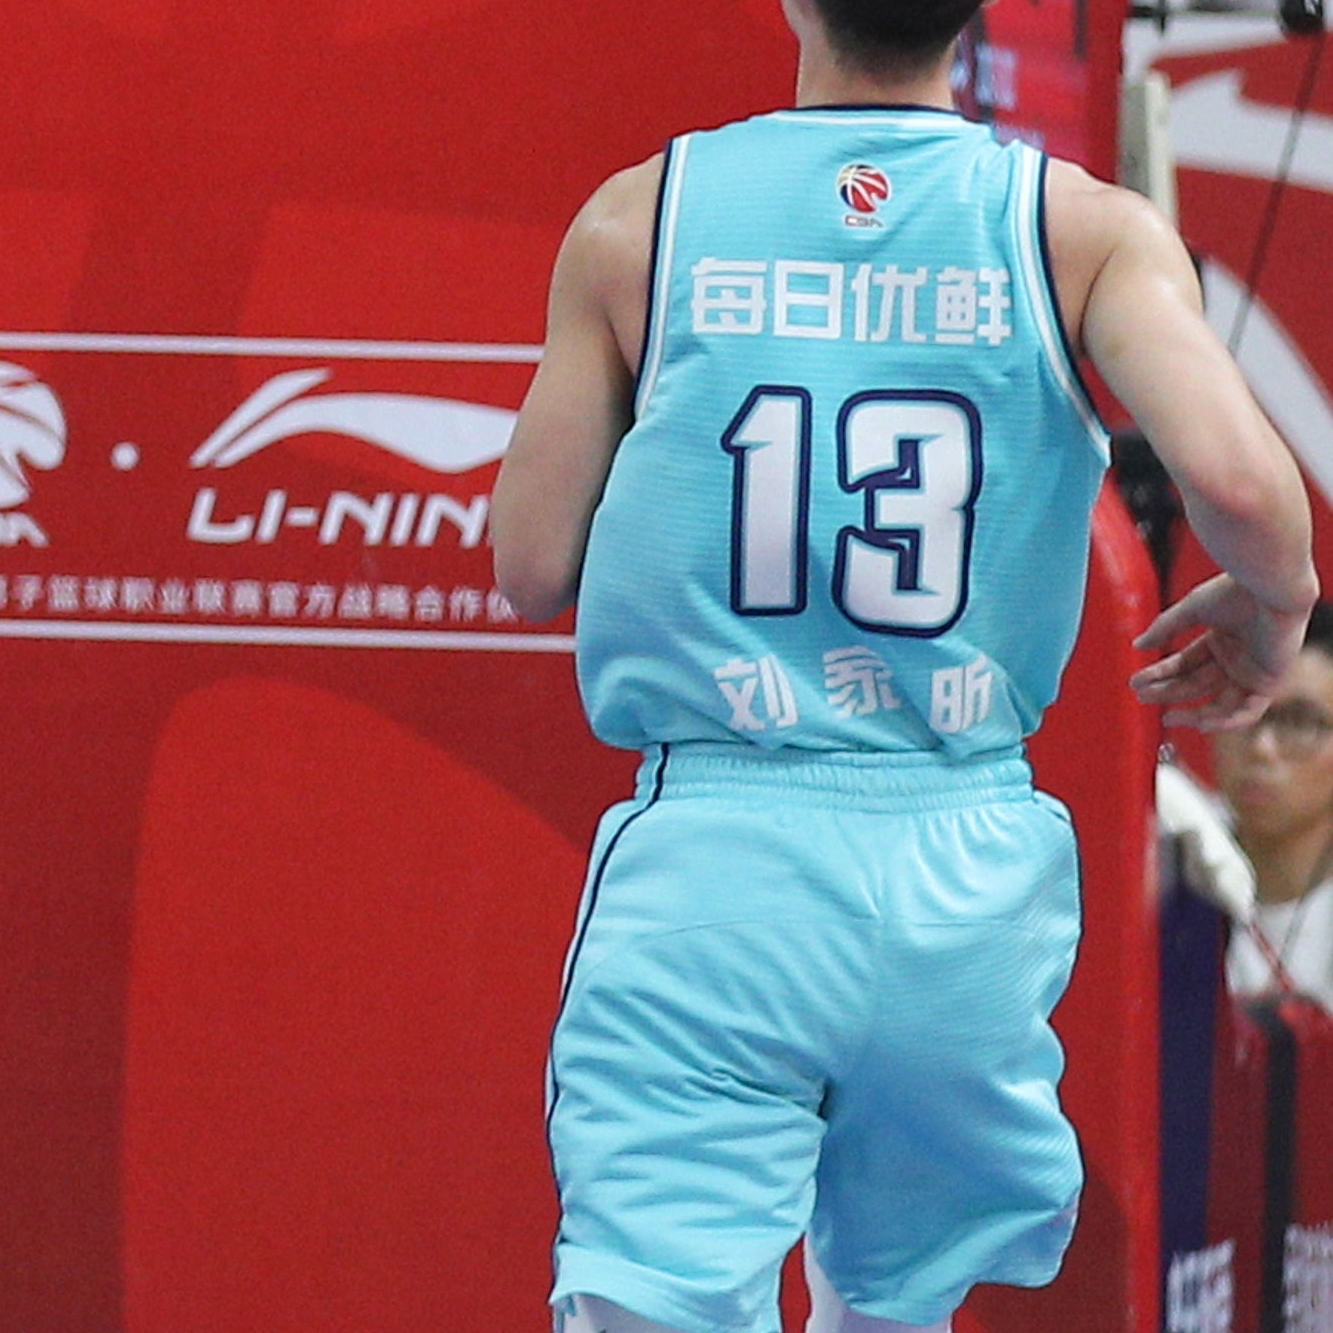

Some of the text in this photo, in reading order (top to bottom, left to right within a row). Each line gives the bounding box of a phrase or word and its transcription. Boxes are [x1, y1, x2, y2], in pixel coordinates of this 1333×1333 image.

[689, 255, 1012, 346] 每日优鲜
[186, 486, 491, 549] LI-NIN
[719, 384, 983, 639] 13
